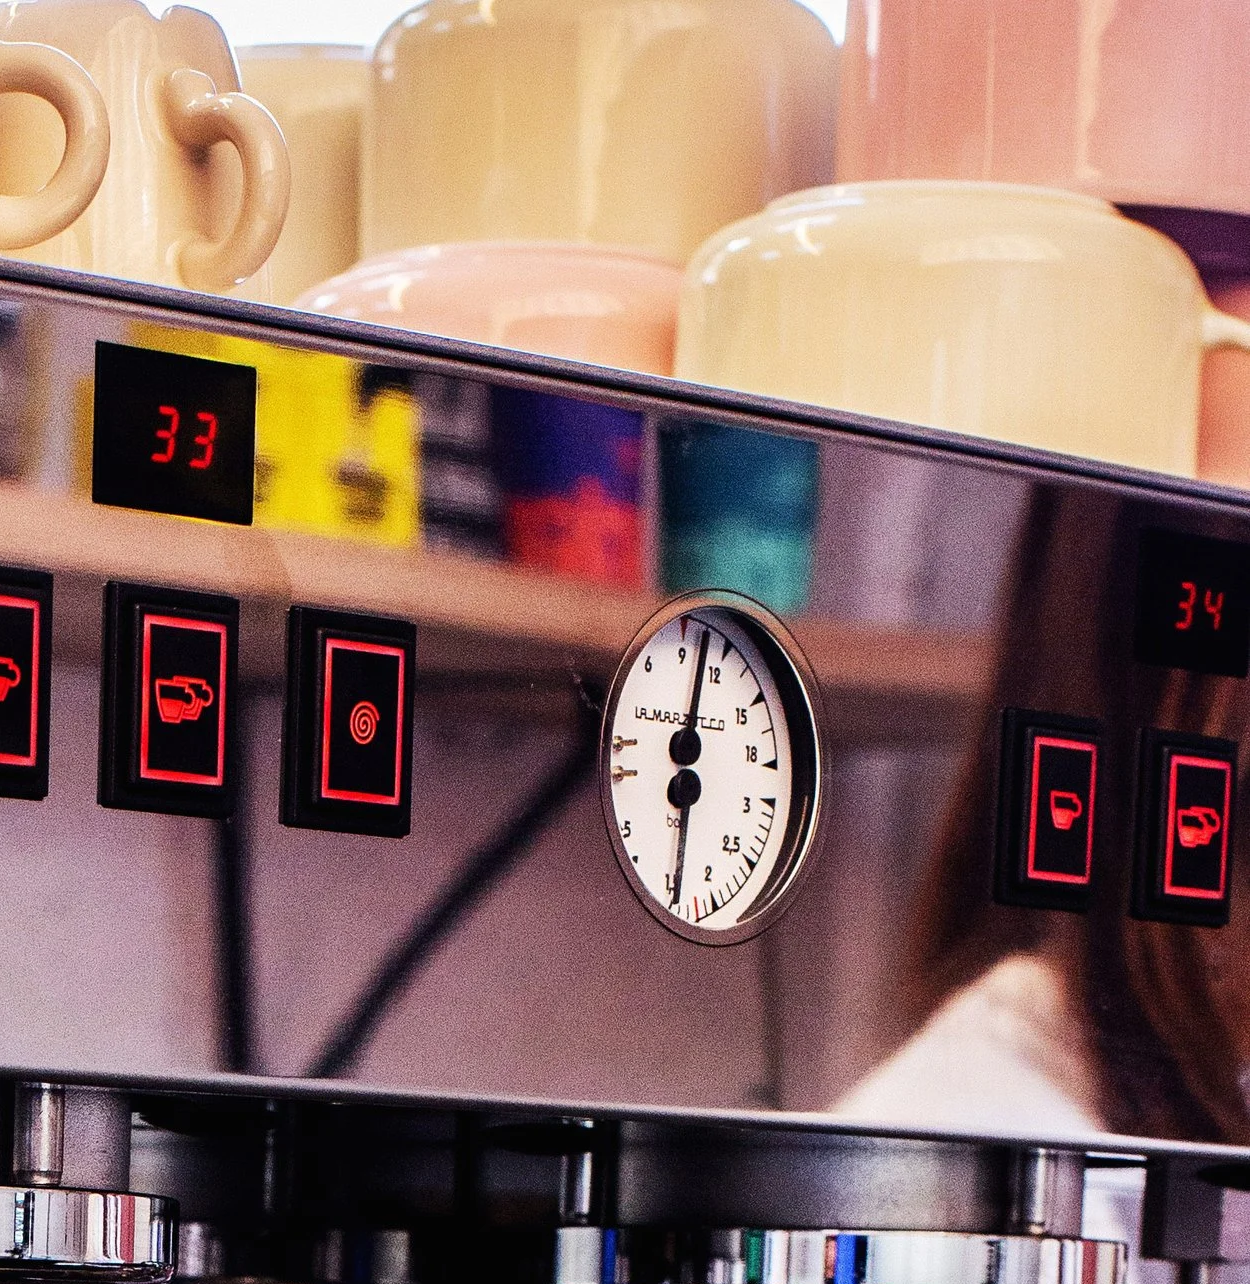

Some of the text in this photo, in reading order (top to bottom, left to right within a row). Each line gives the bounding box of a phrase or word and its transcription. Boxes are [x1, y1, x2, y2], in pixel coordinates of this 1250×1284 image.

[151, 405, 218, 470] 33
[1174, 581, 1224, 631] 34
[678, 647, 686, 664] 9
[644, 656, 652, 673] 6
[709, 666, 721, 684] 12
[653, 708, 725, 731] MARZCCO
[736, 708, 748, 725] 15
[746, 745, 758, 763] 18
[743, 797, 751, 813] 3
[704, 866, 712, 882] 2
